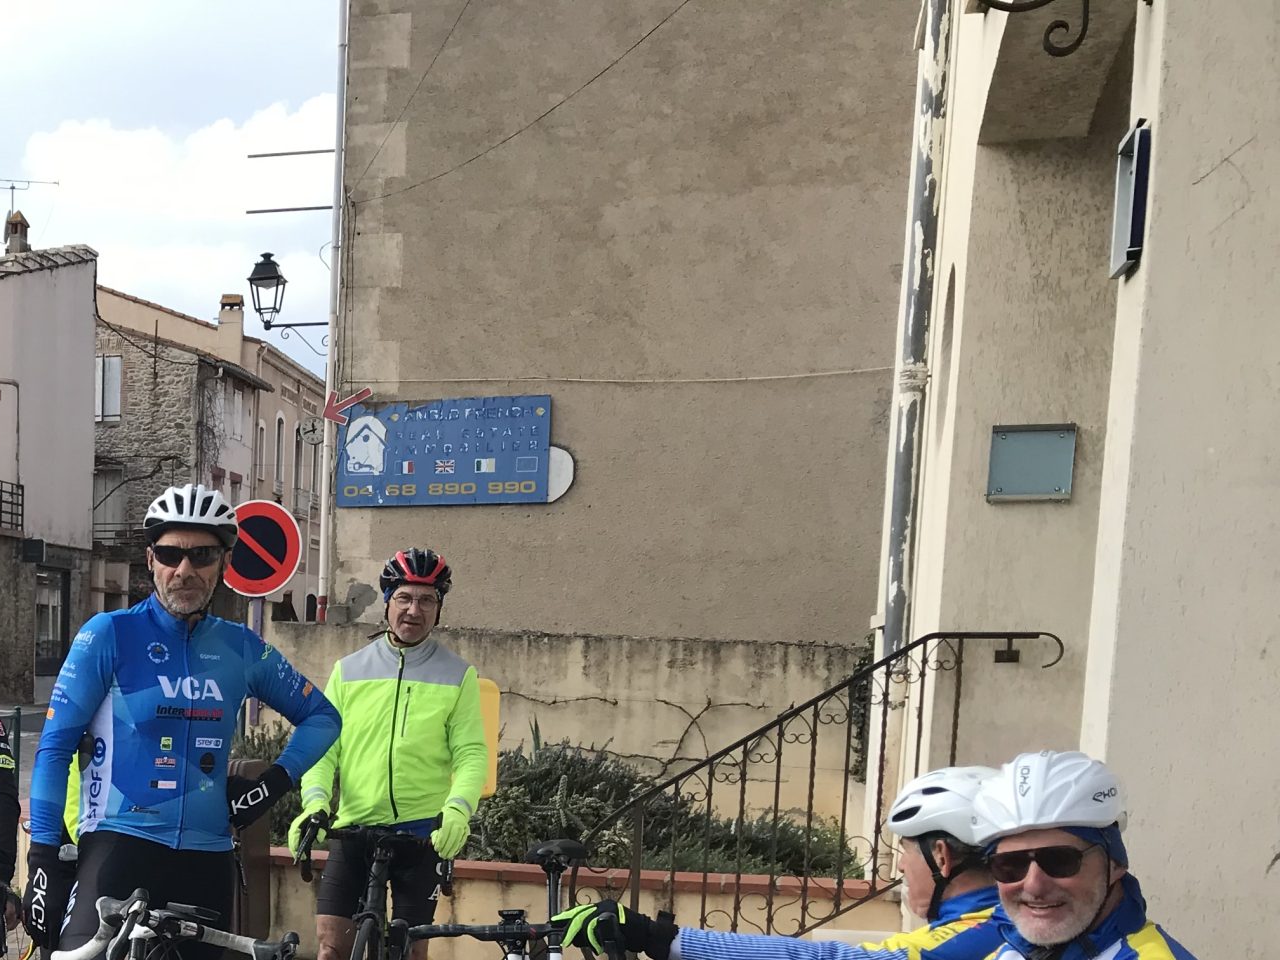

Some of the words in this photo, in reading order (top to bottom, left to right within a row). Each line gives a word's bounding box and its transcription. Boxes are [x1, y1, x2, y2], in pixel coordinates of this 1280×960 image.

[343, 485, 373, 497] 04
[386, 484, 417, 496] 68
[428, 483, 477, 495] 890
[487, 481, 537, 494] 990
[157, 675, 224, 701] VCA
